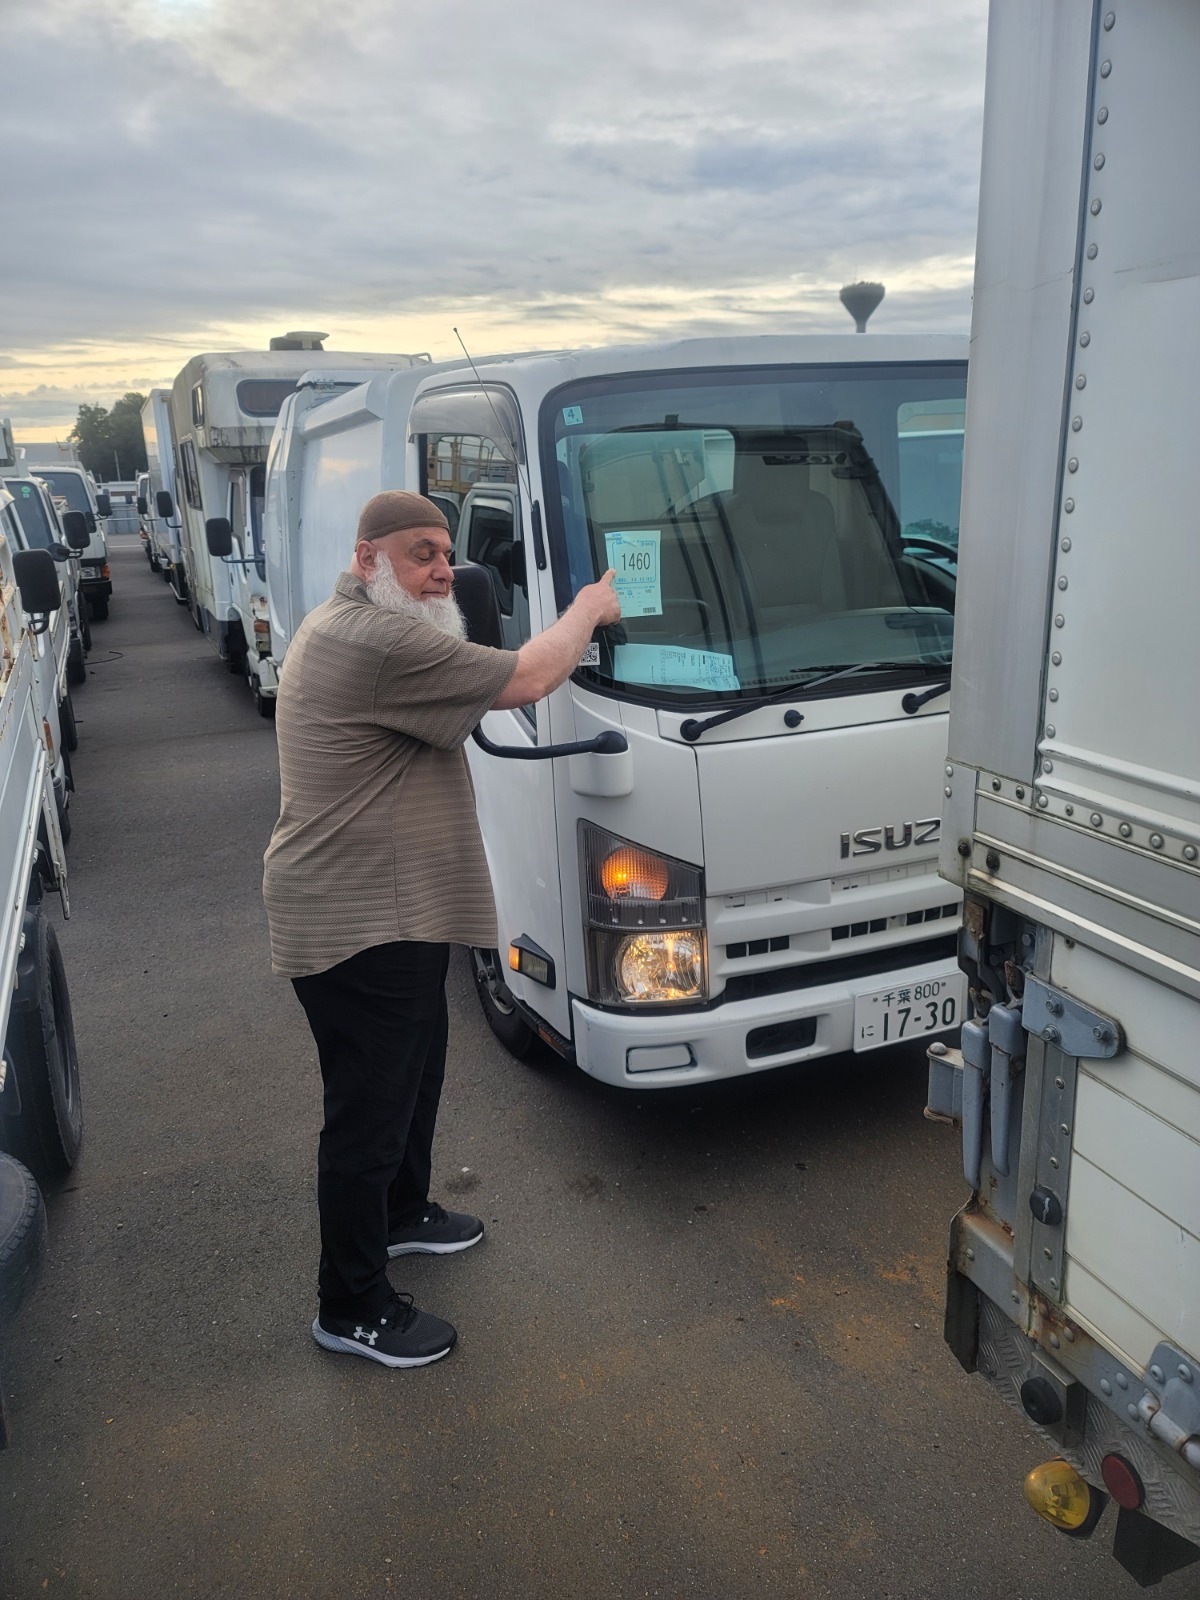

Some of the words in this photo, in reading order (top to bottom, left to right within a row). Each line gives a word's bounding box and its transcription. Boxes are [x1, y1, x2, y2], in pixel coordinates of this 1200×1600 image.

[567, 408, 575, 420] 4
[621, 552, 651, 571] 1460
[840, 817, 941, 859] ISUZ
[882, 989, 912, 1008] 千葉
[914, 981, 940, 1001] 800
[861, 1025, 875, 1039] に
[883, 997, 956, 1041] 17-30
